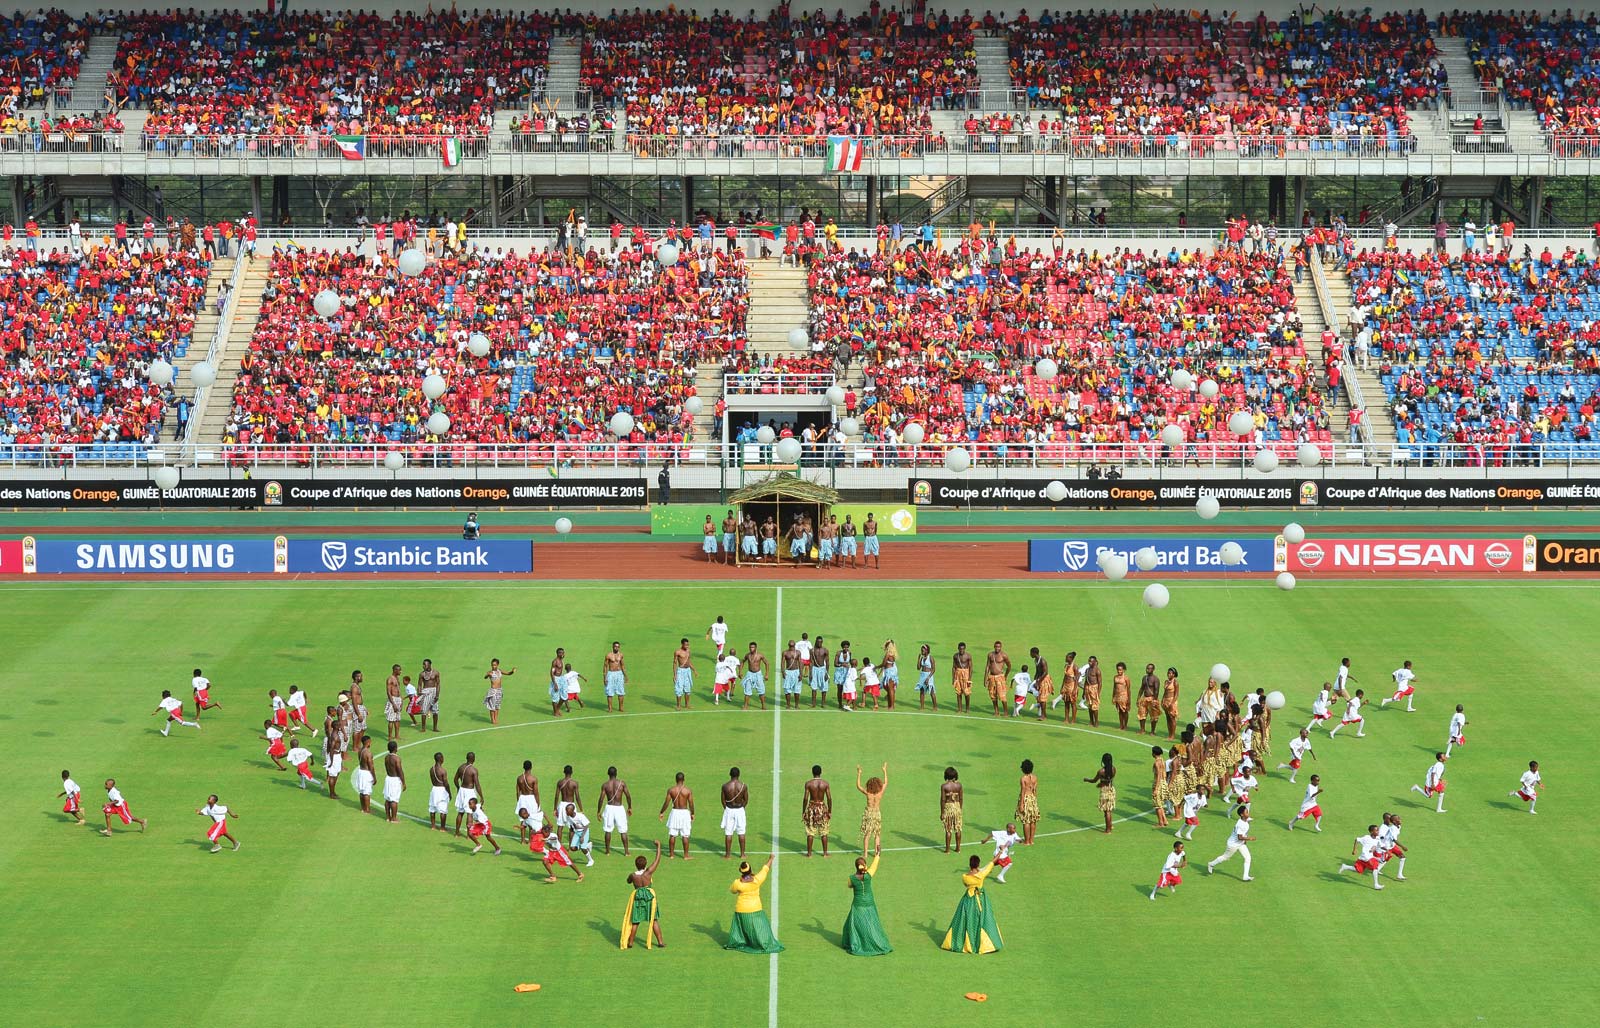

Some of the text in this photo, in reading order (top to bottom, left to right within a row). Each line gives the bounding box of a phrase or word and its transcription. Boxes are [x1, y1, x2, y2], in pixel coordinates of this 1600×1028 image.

[0, 488, 22, 499] des
[26, 488, 71, 499] Nations
[73, 488, 120, 501] Orange,
[123, 486, 160, 499] GUINÉE
[232, 487, 257, 498] 2015
[290, 487, 330, 500] Coupe
[390, 487, 412, 498] des
[416, 487, 461, 498] Nations
[463, 486, 510, 500] Orange,
[513, 484, 549, 497] GUINÉE
[551, 484, 618, 498] ÉQUATORIALE
[620, 487, 645, 497] 2015
[940, 487, 979, 500] Coupe
[1064, 487, 1109, 499] Nations
[1111, 487, 1157, 501] Orange,
[1160, 485, 1196, 499] GUINÉE
[1267, 488, 1292, 499] 2015
[1326, 487, 1365, 500] Coupe
[1425, 487, 1447, 498] des
[1450, 487, 1496, 498] Nations
[1497, 486, 1544, 500] Orange,
[1547, 484, 1583, 498] GUINÉE
[76, 544, 235, 569] SAMSUNG
[354, 546, 489, 566] Stanbic Bank
[1196, 546, 1248, 566] Bak
[1334, 544, 1475, 566] NISSAN
